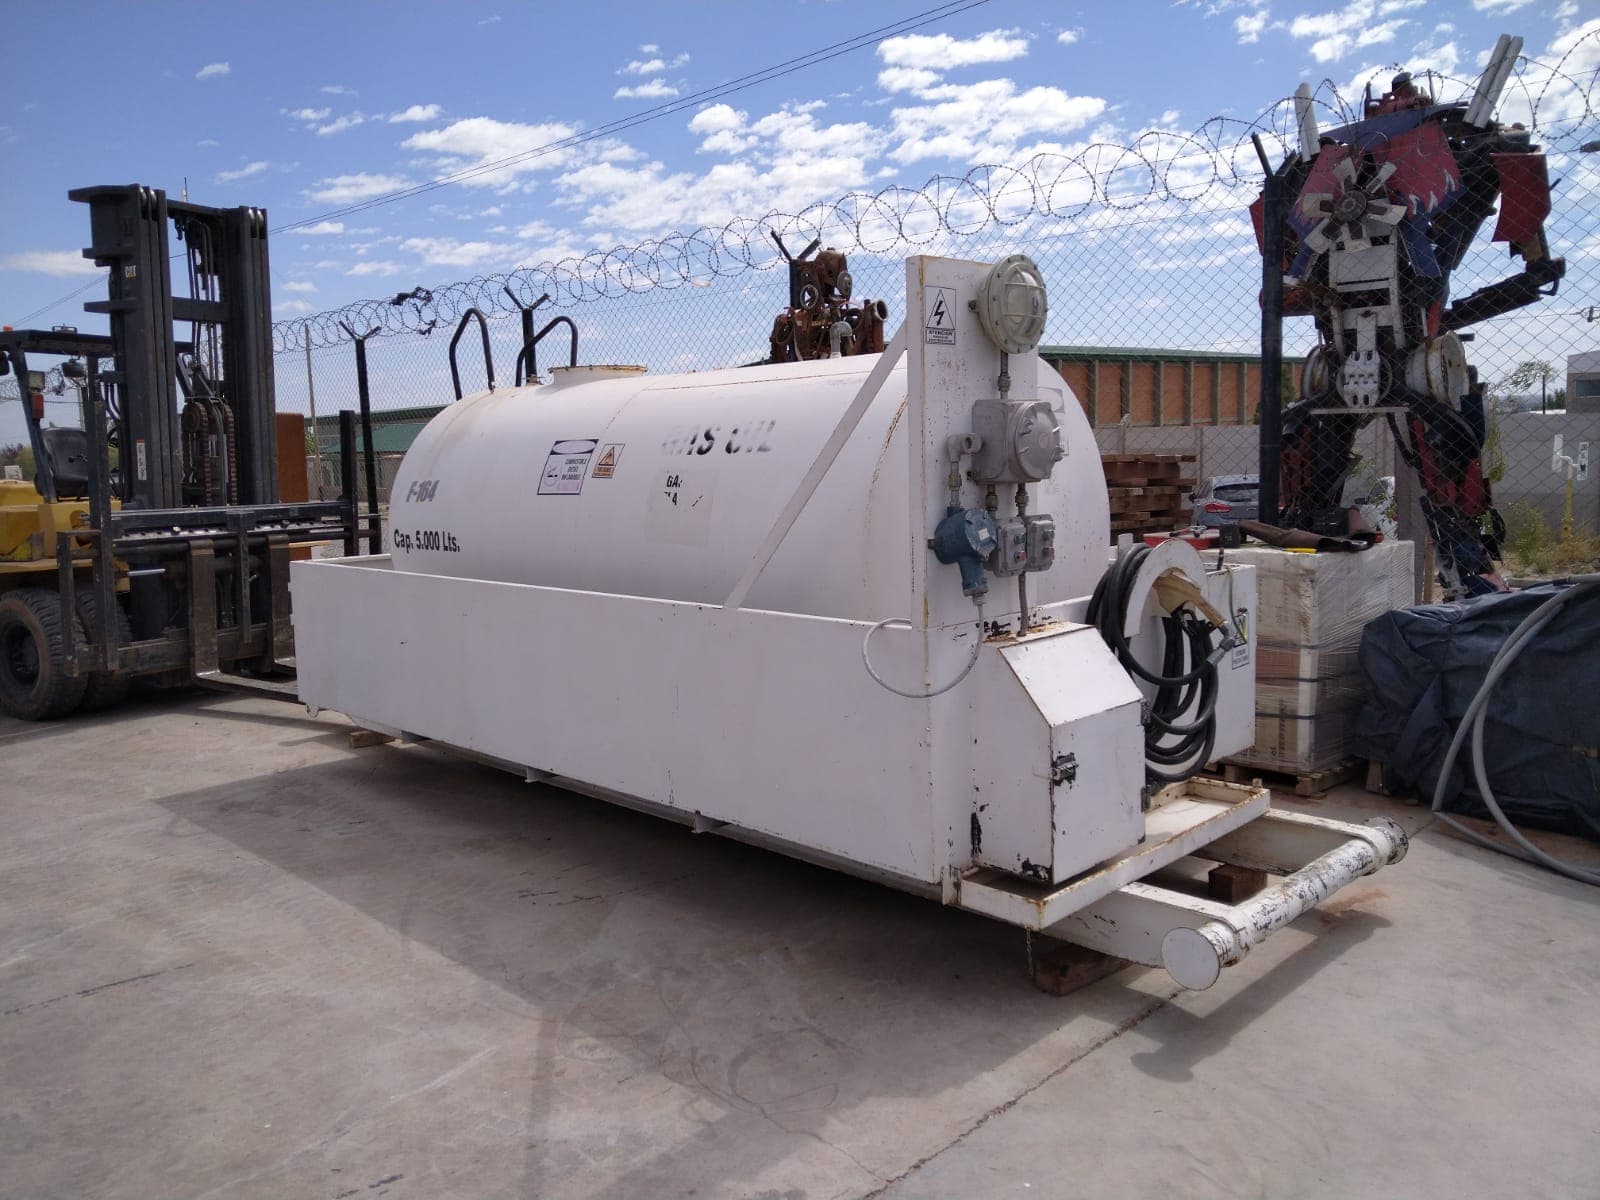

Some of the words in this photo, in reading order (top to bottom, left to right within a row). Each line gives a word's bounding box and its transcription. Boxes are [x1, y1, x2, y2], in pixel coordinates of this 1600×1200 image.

[405, 479, 441, 503] F-164
[393, 528, 414, 554] Cap.
[415, 530, 440, 551] 5.000
[442, 531, 461, 553] Lts.
